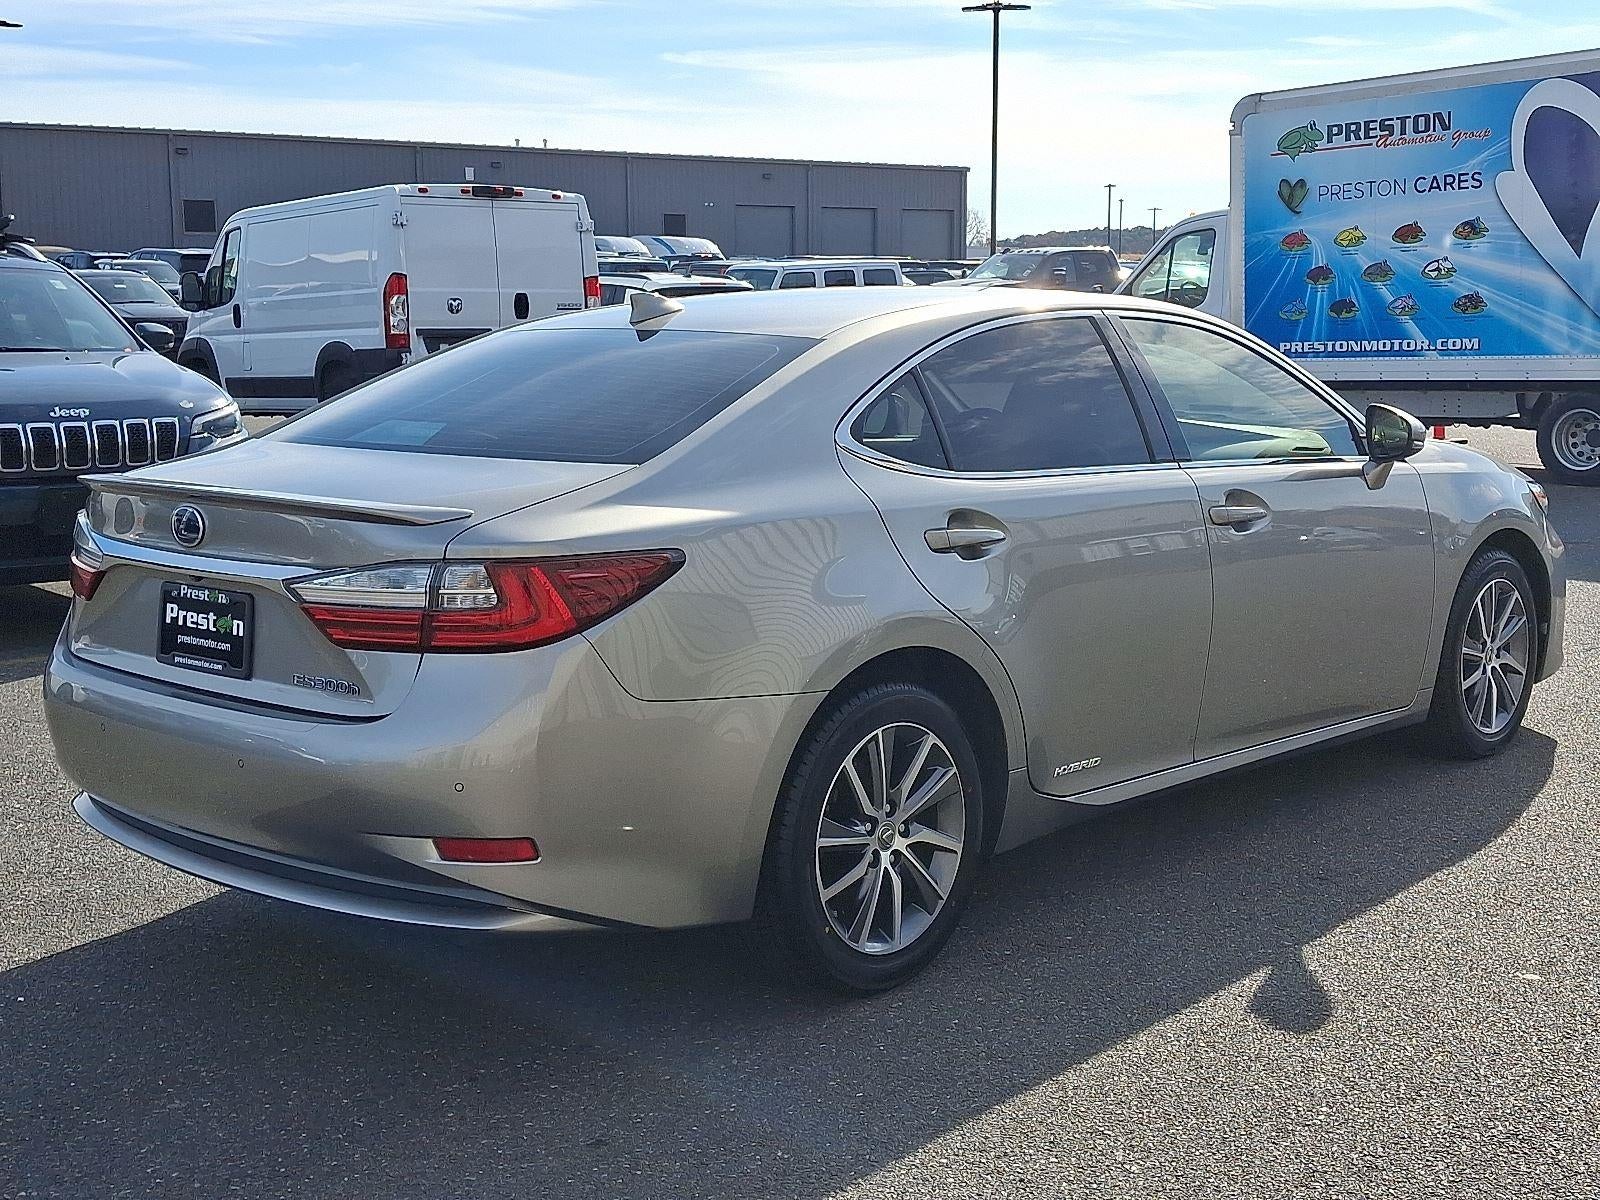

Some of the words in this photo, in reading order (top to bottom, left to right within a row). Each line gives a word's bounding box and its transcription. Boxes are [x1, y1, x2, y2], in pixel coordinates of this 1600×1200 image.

[1326, 110, 1452, 144] PRESTON
[1375, 133, 1448, 149] Automotive
[1451, 127, 1493, 149] Group
[1318, 178, 1408, 203] PRESTON
[1413, 171, 1484, 194] CARES
[1279, 338, 1481, 354] PRESTONMOTOR.COM
[49, 406, 90, 419] Jeep
[177, 634, 231, 652] prestonmotor.com
[174, 656, 223, 671] prestonmotor.com
[292, 673, 361, 697] ES300h
[1053, 756, 1102, 778] HYBRID
